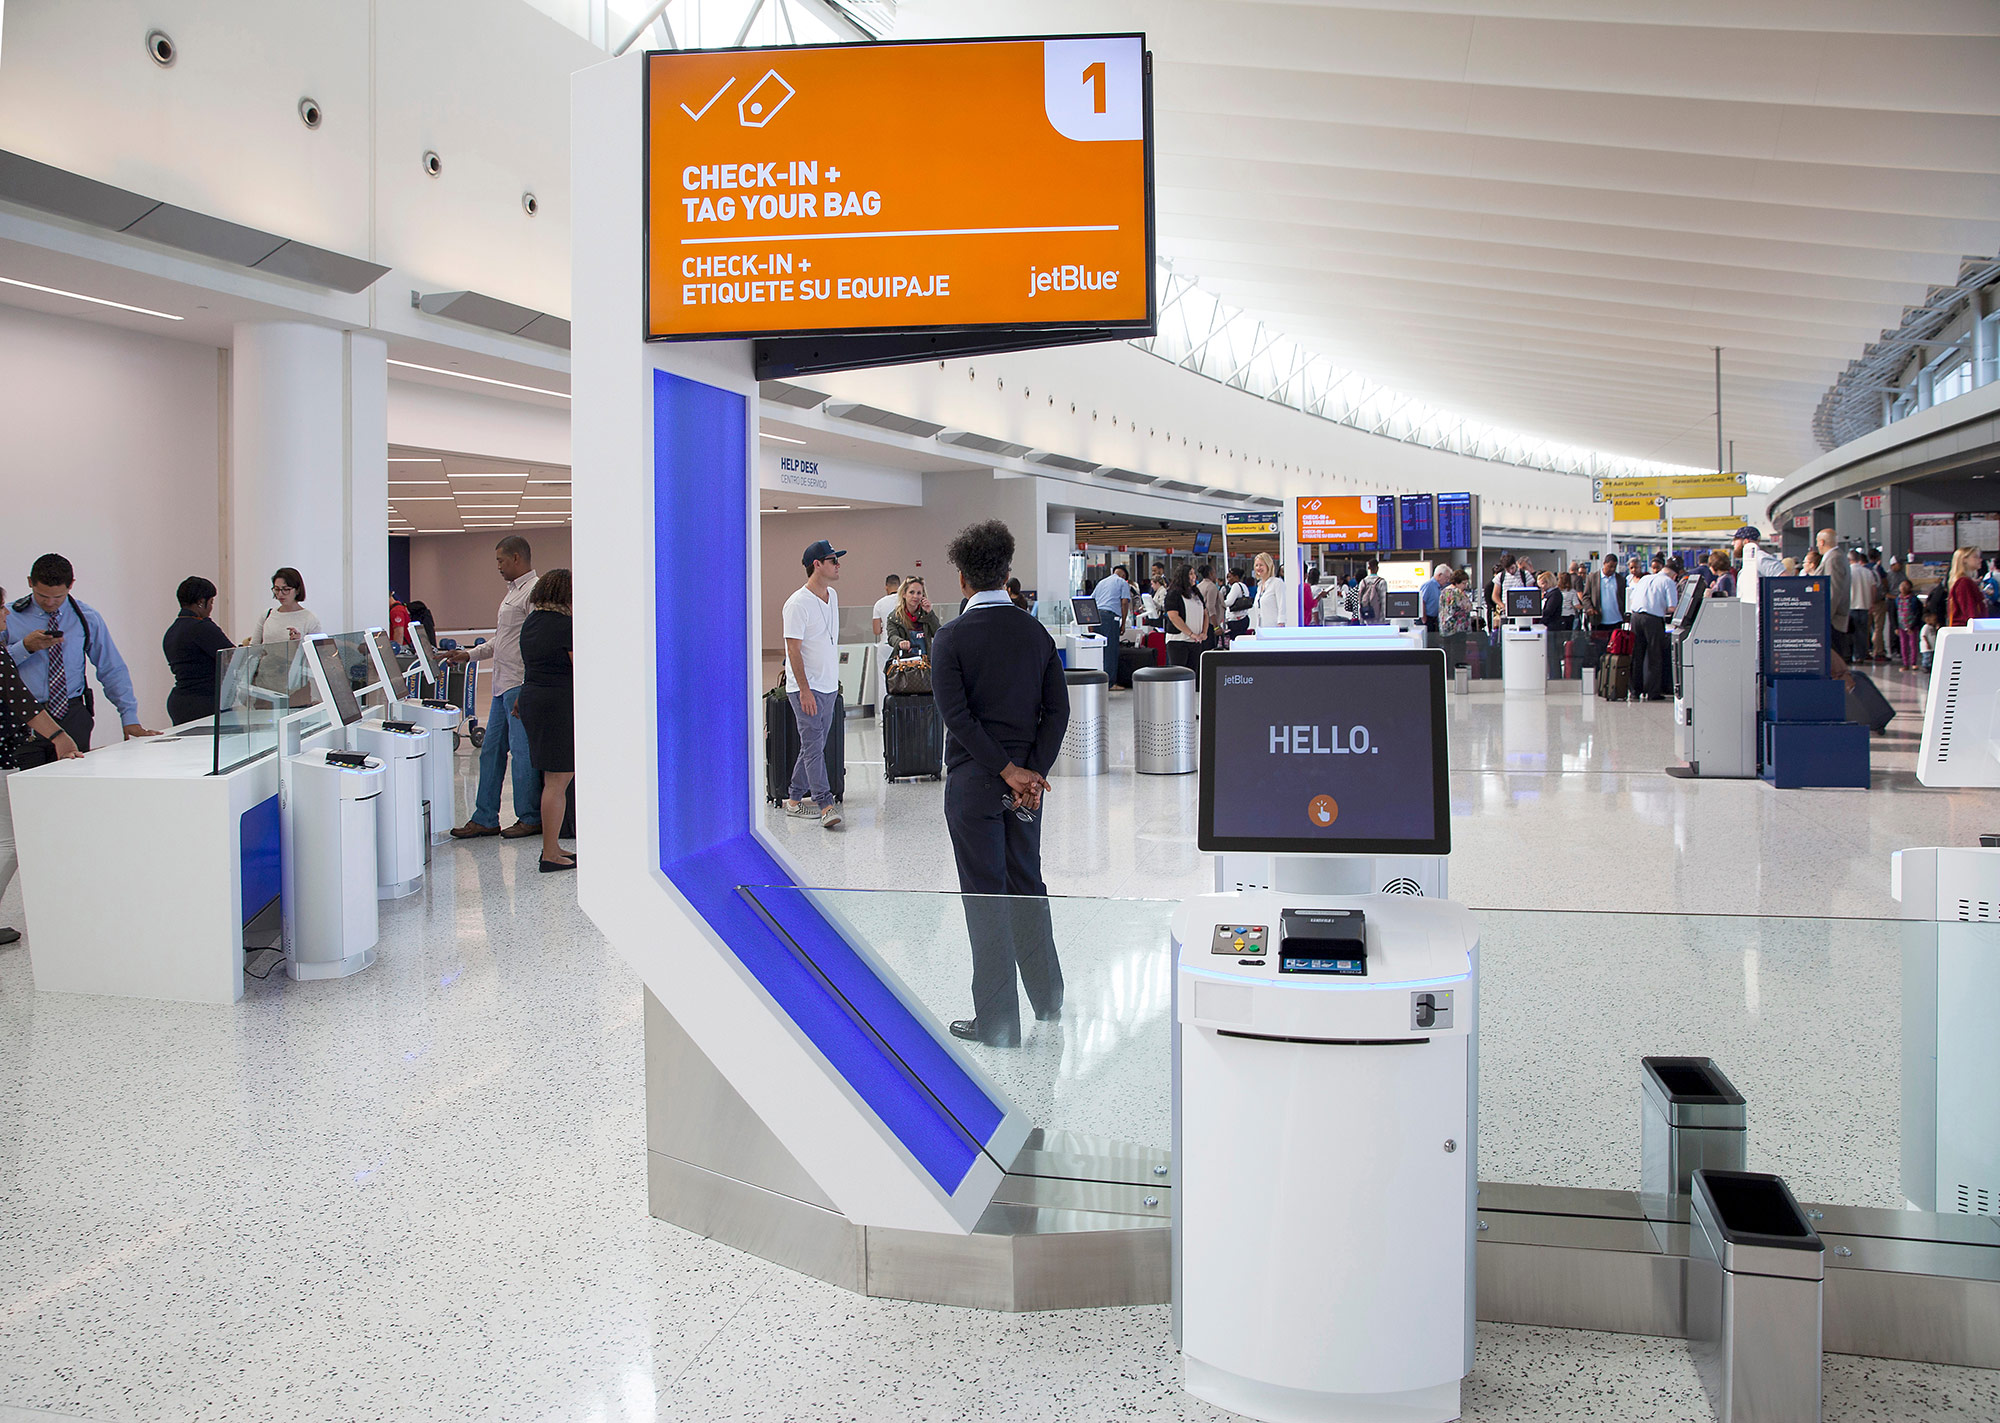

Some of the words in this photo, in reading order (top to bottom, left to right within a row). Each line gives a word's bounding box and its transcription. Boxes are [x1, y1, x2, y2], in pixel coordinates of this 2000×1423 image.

[1082, 61, 1106, 114] 1
[682, 160, 818, 191] CHECK-IN
[825, 166, 840, 183] +
[682, 196, 736, 223] TAG
[740, 192, 818, 221] YOUR
[824, 190, 882, 218] BAG
[682, 253, 792, 279] CHECK-IN
[798, 259, 811, 272] +
[682, 279, 794, 306] ETIQUETE
[799, 278, 831, 301] SU
[838, 274, 950, 301] EQUIPAJE
[1028, 264, 1120, 298] jetBlue
[781, 457, 800, 472] HELP
[800, 460, 819, 475] DESK
[780, 474, 800, 486] CENTRO
[800, 477, 807, 486] DE
[1367, 500, 1372, 508] 1
[1864, 496, 1881, 510] EXIT
[1795, 516, 1809, 527] EXIT
[1224, 674, 1254, 686] jetBlue
[1269, 725, 1379, 755] HELLO.
